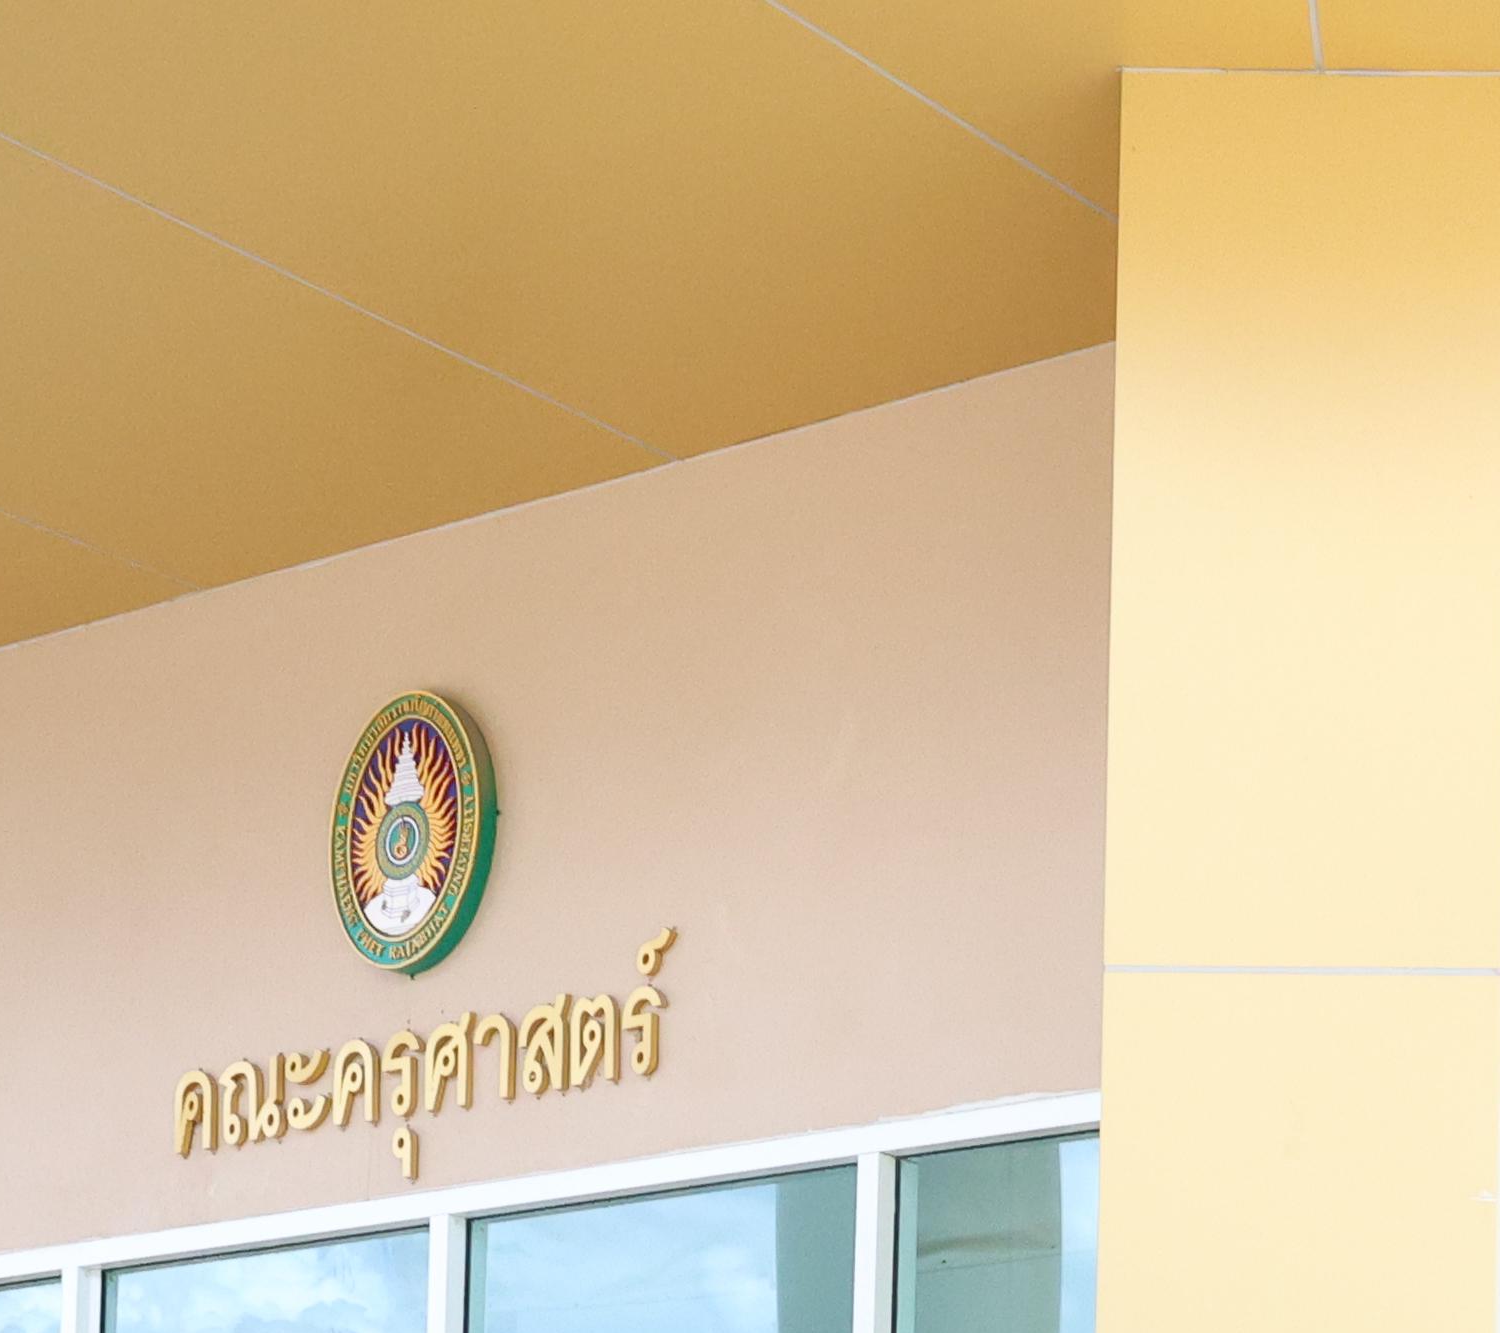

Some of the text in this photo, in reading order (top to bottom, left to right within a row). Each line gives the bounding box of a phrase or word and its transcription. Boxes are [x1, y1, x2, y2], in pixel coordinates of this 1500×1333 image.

[173, 926, 677, 1180] คณะครุศาสตร์
